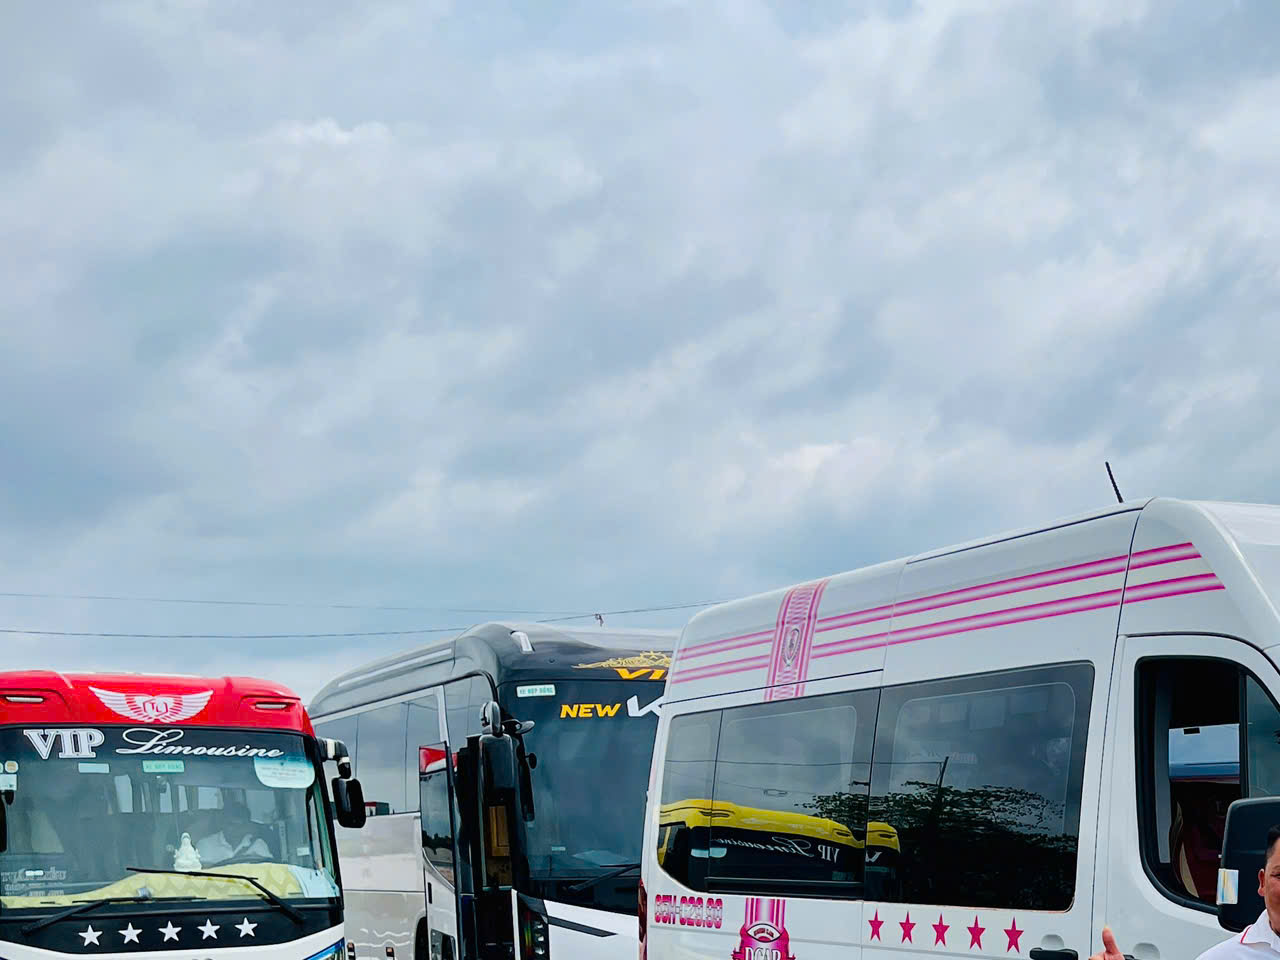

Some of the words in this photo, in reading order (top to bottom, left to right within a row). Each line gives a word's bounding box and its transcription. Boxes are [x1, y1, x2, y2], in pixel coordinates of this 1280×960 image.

[614, 667, 668, 680] VI
[560, 703, 622, 718] NEW
[24, 728, 105, 760] VIP
[115, 728, 284, 759] Limousine
